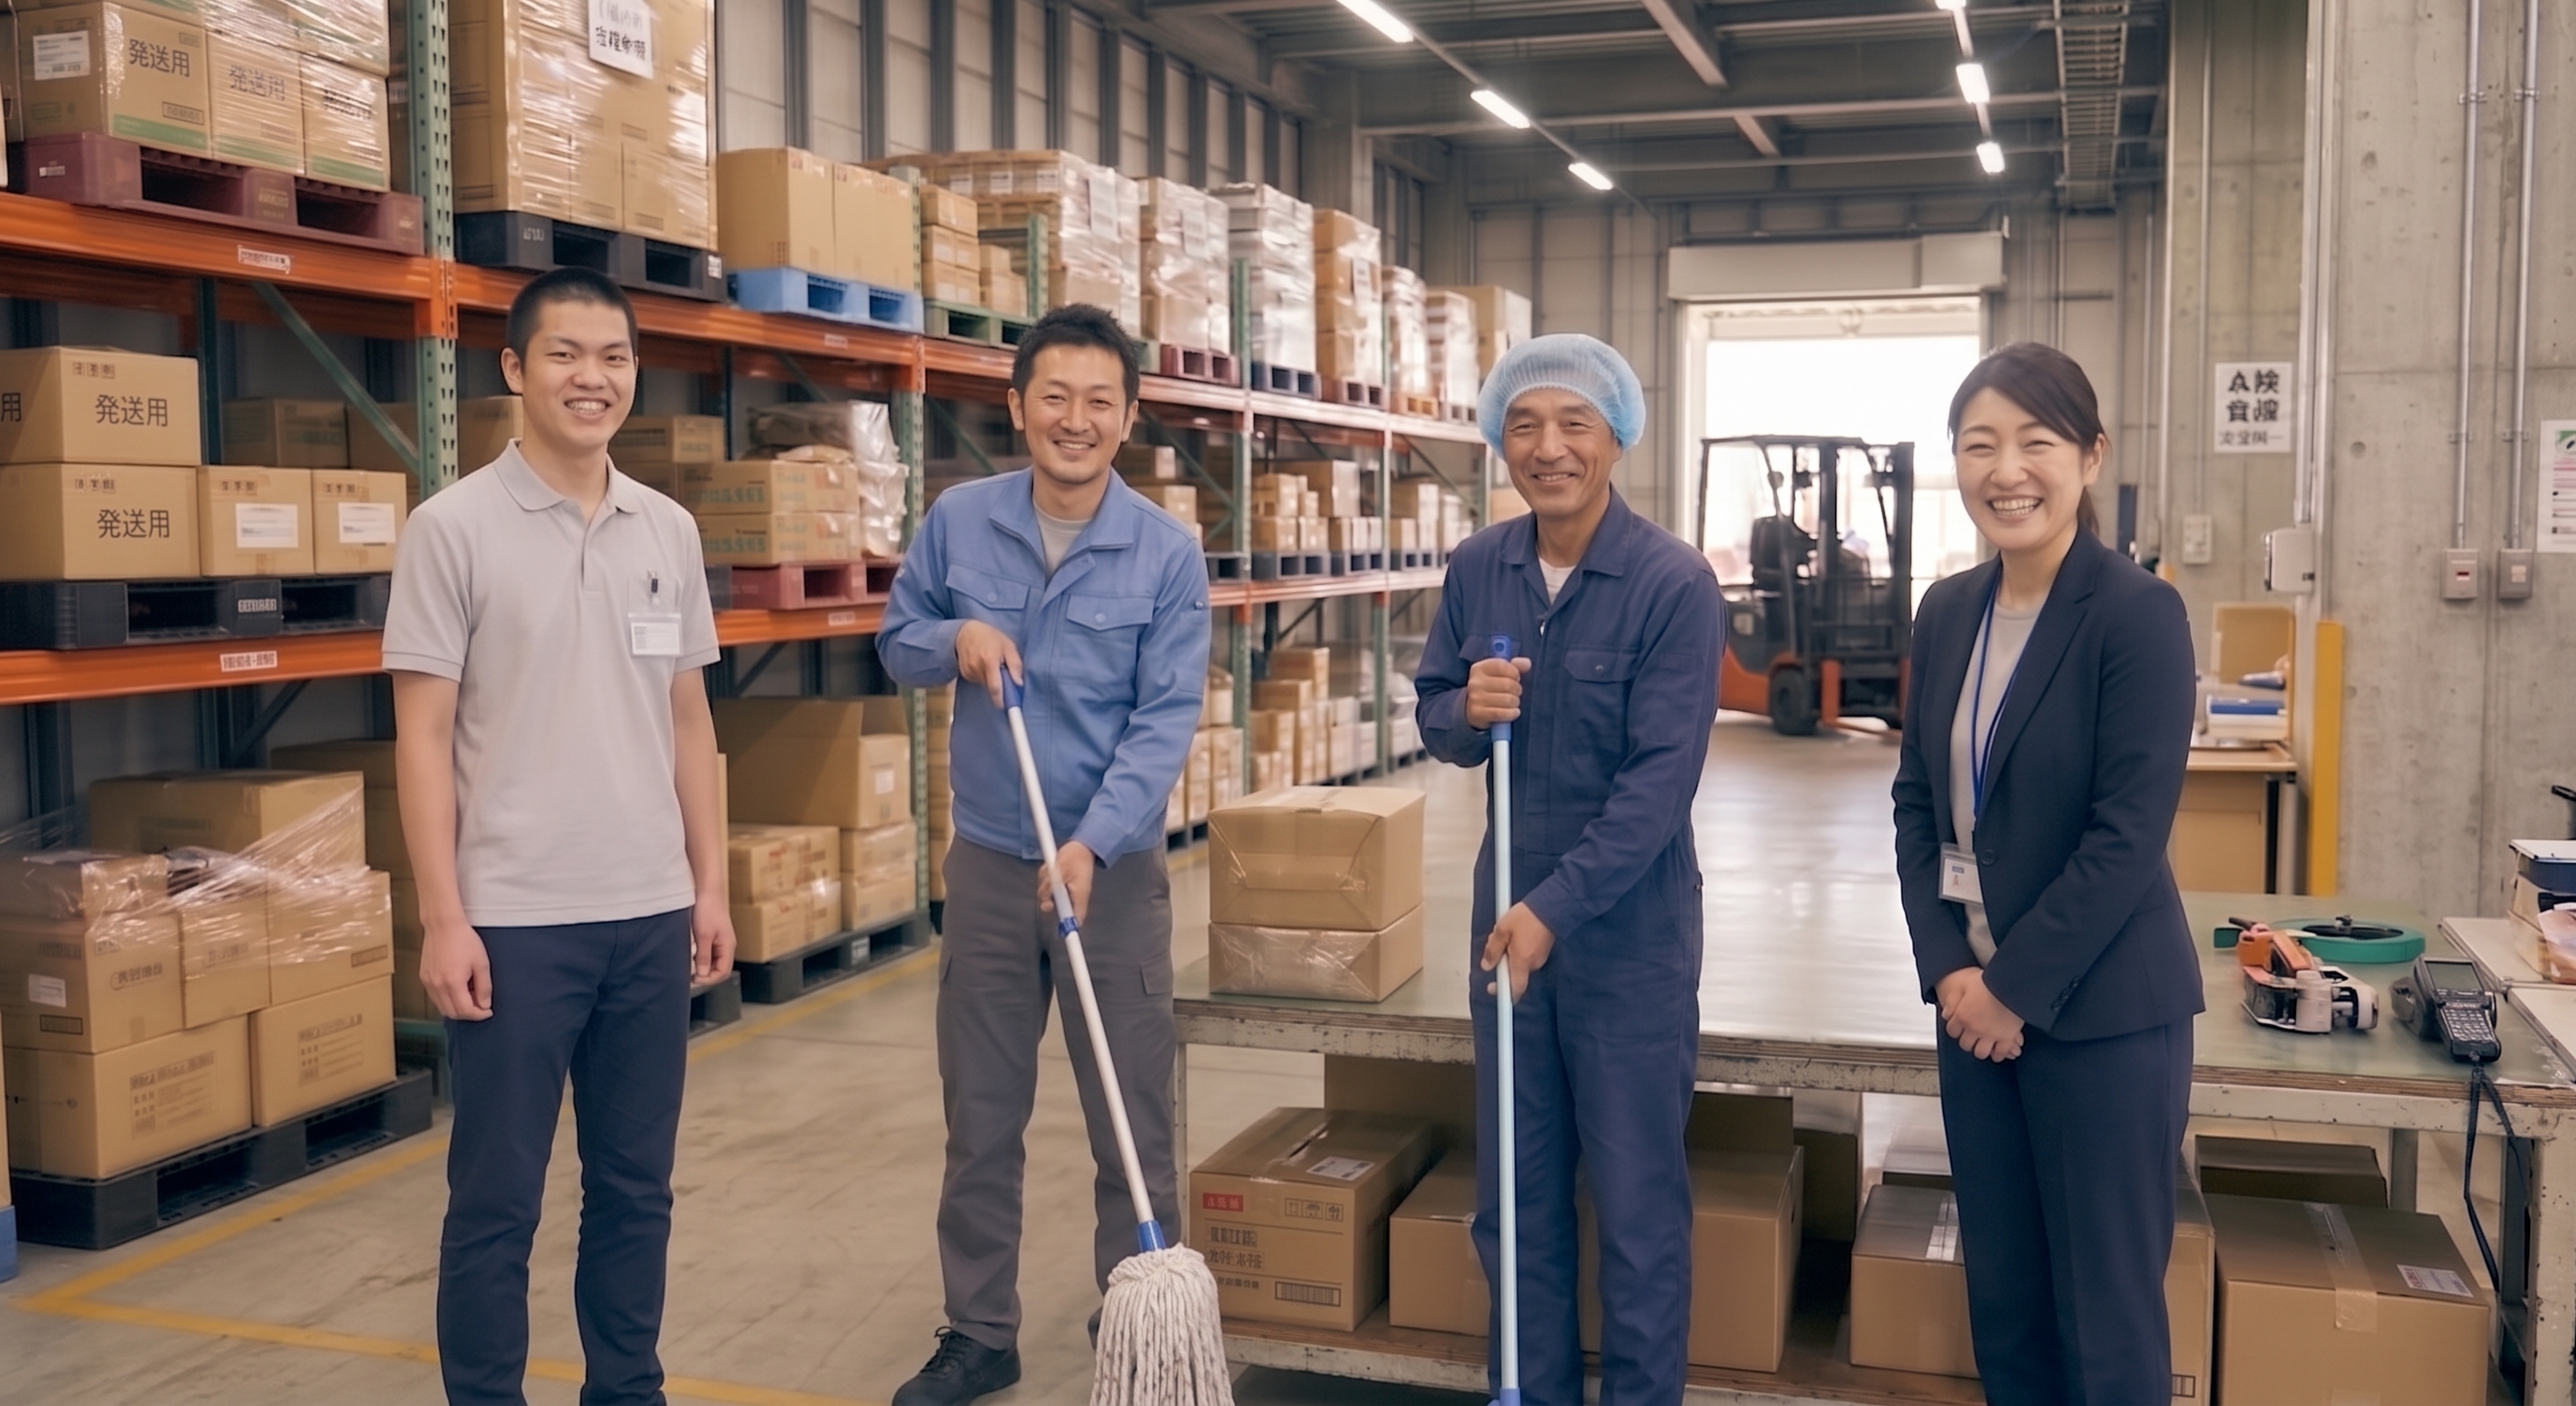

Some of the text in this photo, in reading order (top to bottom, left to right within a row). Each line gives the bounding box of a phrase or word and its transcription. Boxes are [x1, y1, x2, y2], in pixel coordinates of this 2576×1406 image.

[129, 38, 190, 78] 発送用
[1, 392, 22, 422] 用
[95, 395, 168, 427] 発送用
[97, 509, 170, 539] 発送用
